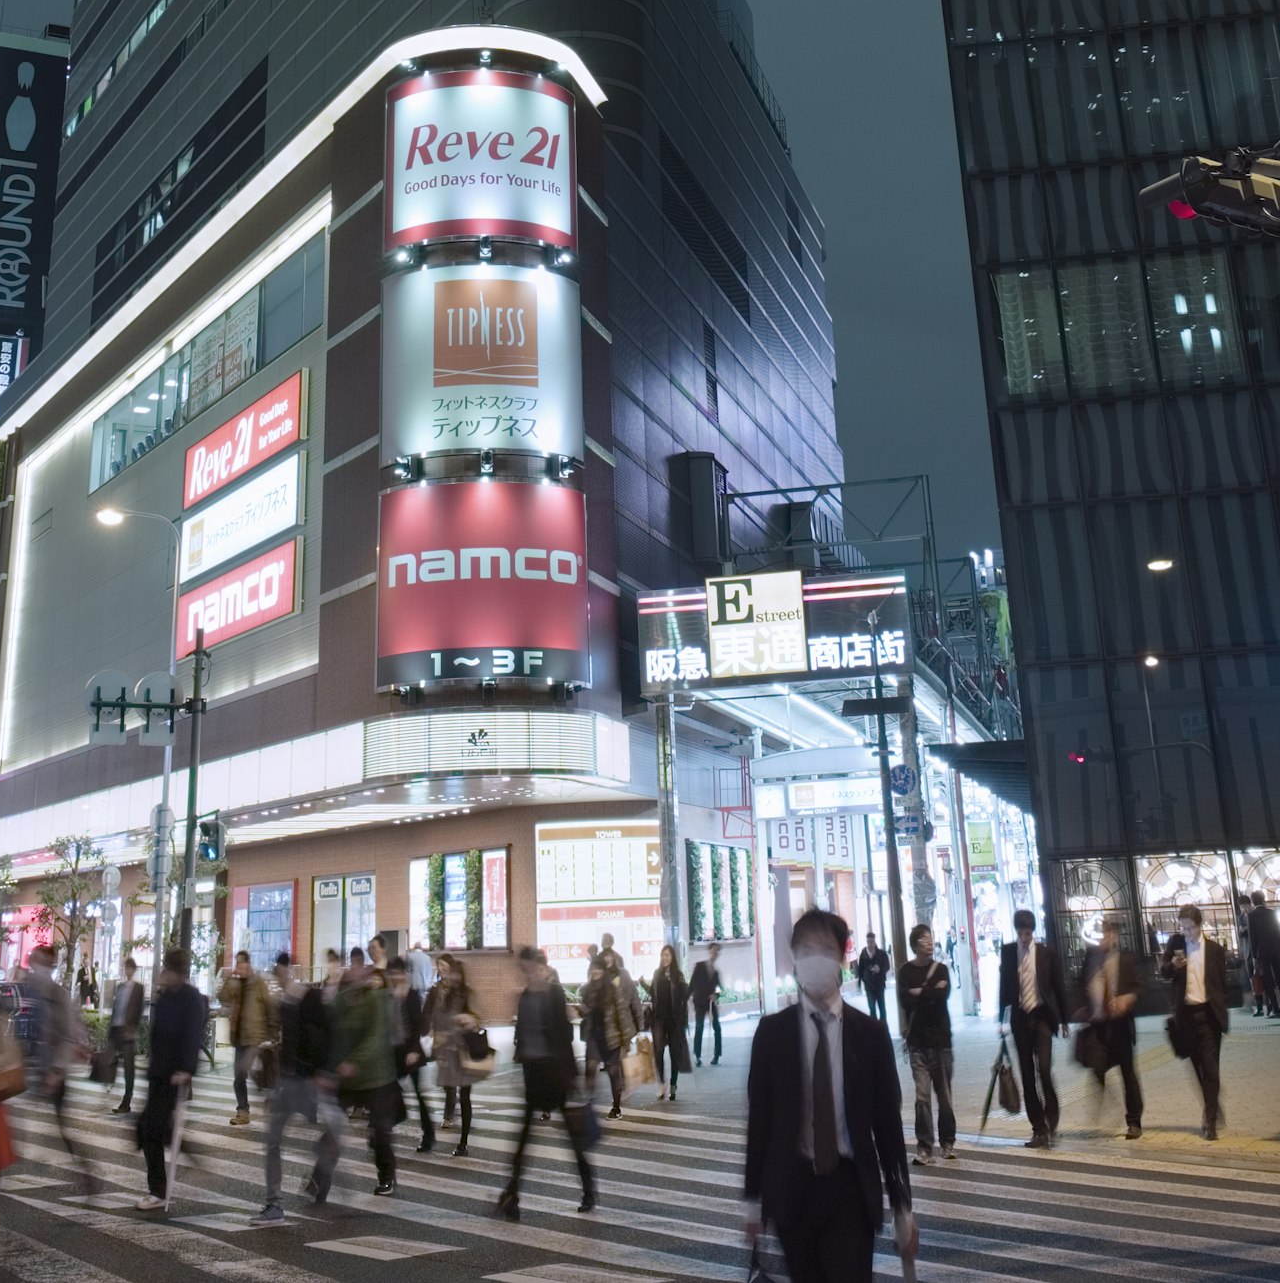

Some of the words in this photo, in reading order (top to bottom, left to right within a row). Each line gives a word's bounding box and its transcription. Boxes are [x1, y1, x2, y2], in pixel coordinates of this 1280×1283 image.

[405, 124, 515, 171] Reve
[520, 126, 561, 170] 21
[404, 176, 437, 194] Good
[440, 173, 476, 188] Days
[480, 172, 503, 185] for
[506, 173, 539, 189] Your
[541, 179, 561, 196] Life
[447, 290, 526, 361] TIPNESS
[259, 407, 274, 427] Good
[274, 399, 289, 418] Days
[432, 396, 539, 412] フィットネスクラブ
[267, 425, 282, 445] Your
[432, 415, 538, 439] ティップネス
[189, 440, 232, 501] Reve
[231, 411, 255, 474] 21
[245, 484, 288, 527] ティップネス
[388, 547, 578, 588] namco
[187, 562, 280, 642] namco
[708, 578, 755, 626] E
[755, 607, 802, 623] street
[595, 830, 622, 839] TOWER
[320, 883, 338, 896] Berlitz
[352, 878, 370, 894] Berlitz
